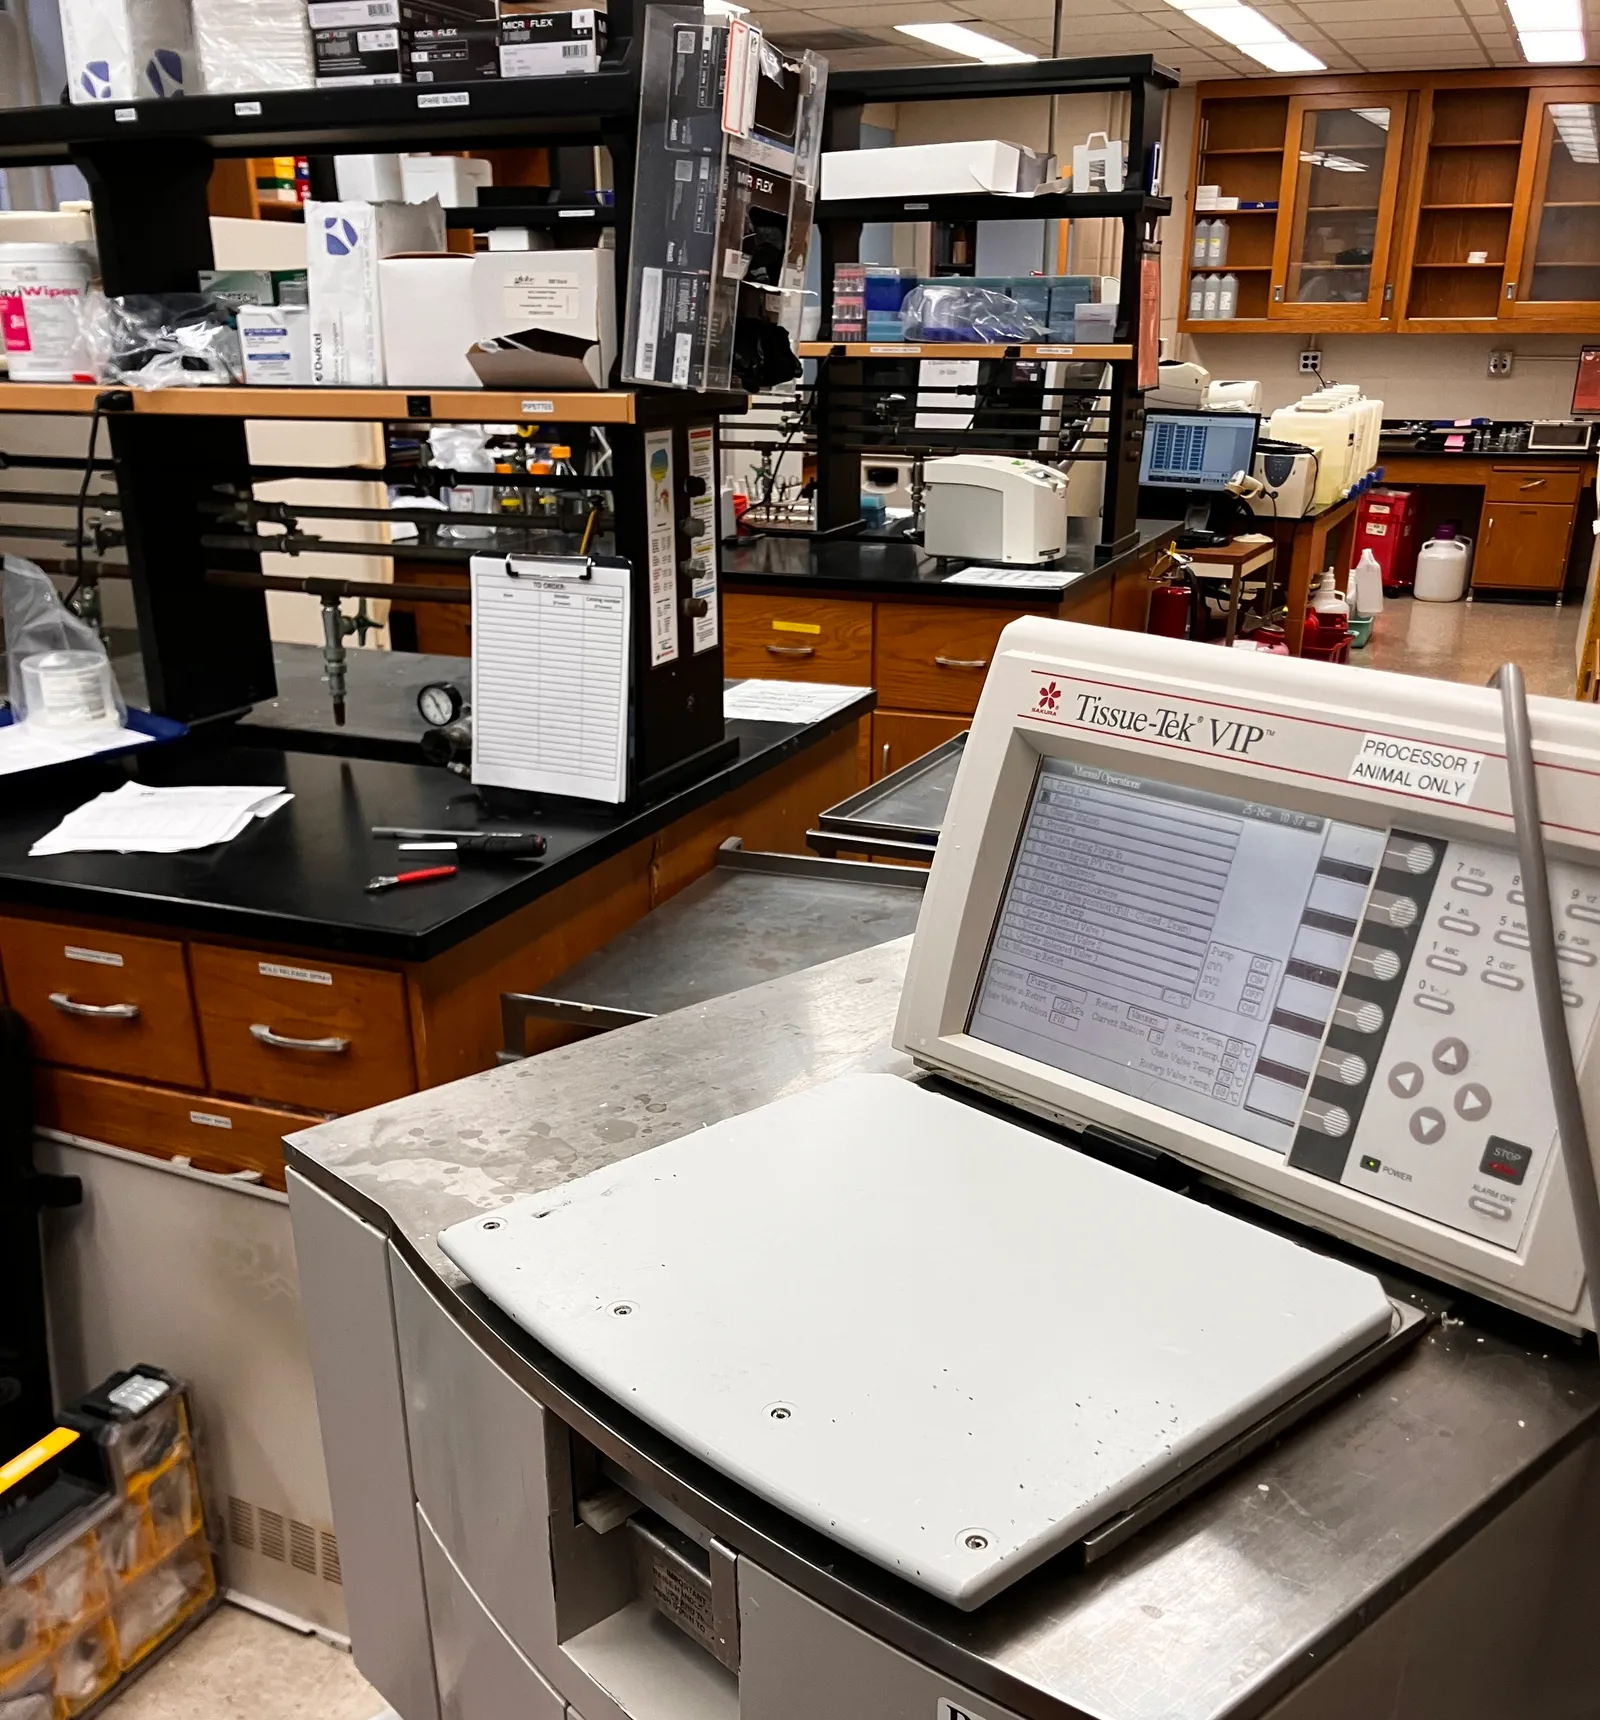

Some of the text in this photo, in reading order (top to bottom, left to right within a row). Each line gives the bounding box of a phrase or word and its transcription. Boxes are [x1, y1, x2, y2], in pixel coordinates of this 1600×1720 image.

[1031, 707, 1057, 716] SAKURA
[1363, 739, 1482, 775] PROCESSOR 1
[1072, 765, 1141, 790] Manual Operations
[1352, 762, 1466, 797] ANIMAL ONLY
[1457, 862, 1465, 872] 7
[1512, 875, 1520, 886] 8
[1571, 889, 1580, 900] 9
[1064, 904, 1084, 919] Pump
[1443, 903, 1451, 911] 4
[1499, 915, 1507, 926] 5
[1557, 931, 1566, 942] 6
[1485, 956, 1494, 967] 2
[1418, 979, 1426, 990] 0
[1052, 1012, 1066, 1024] Fill
[1492, 1147, 1522, 1162] STOP
[1382, 1165, 1413, 1183] POWER
[1471, 1183, 1499, 1198] ALARM
